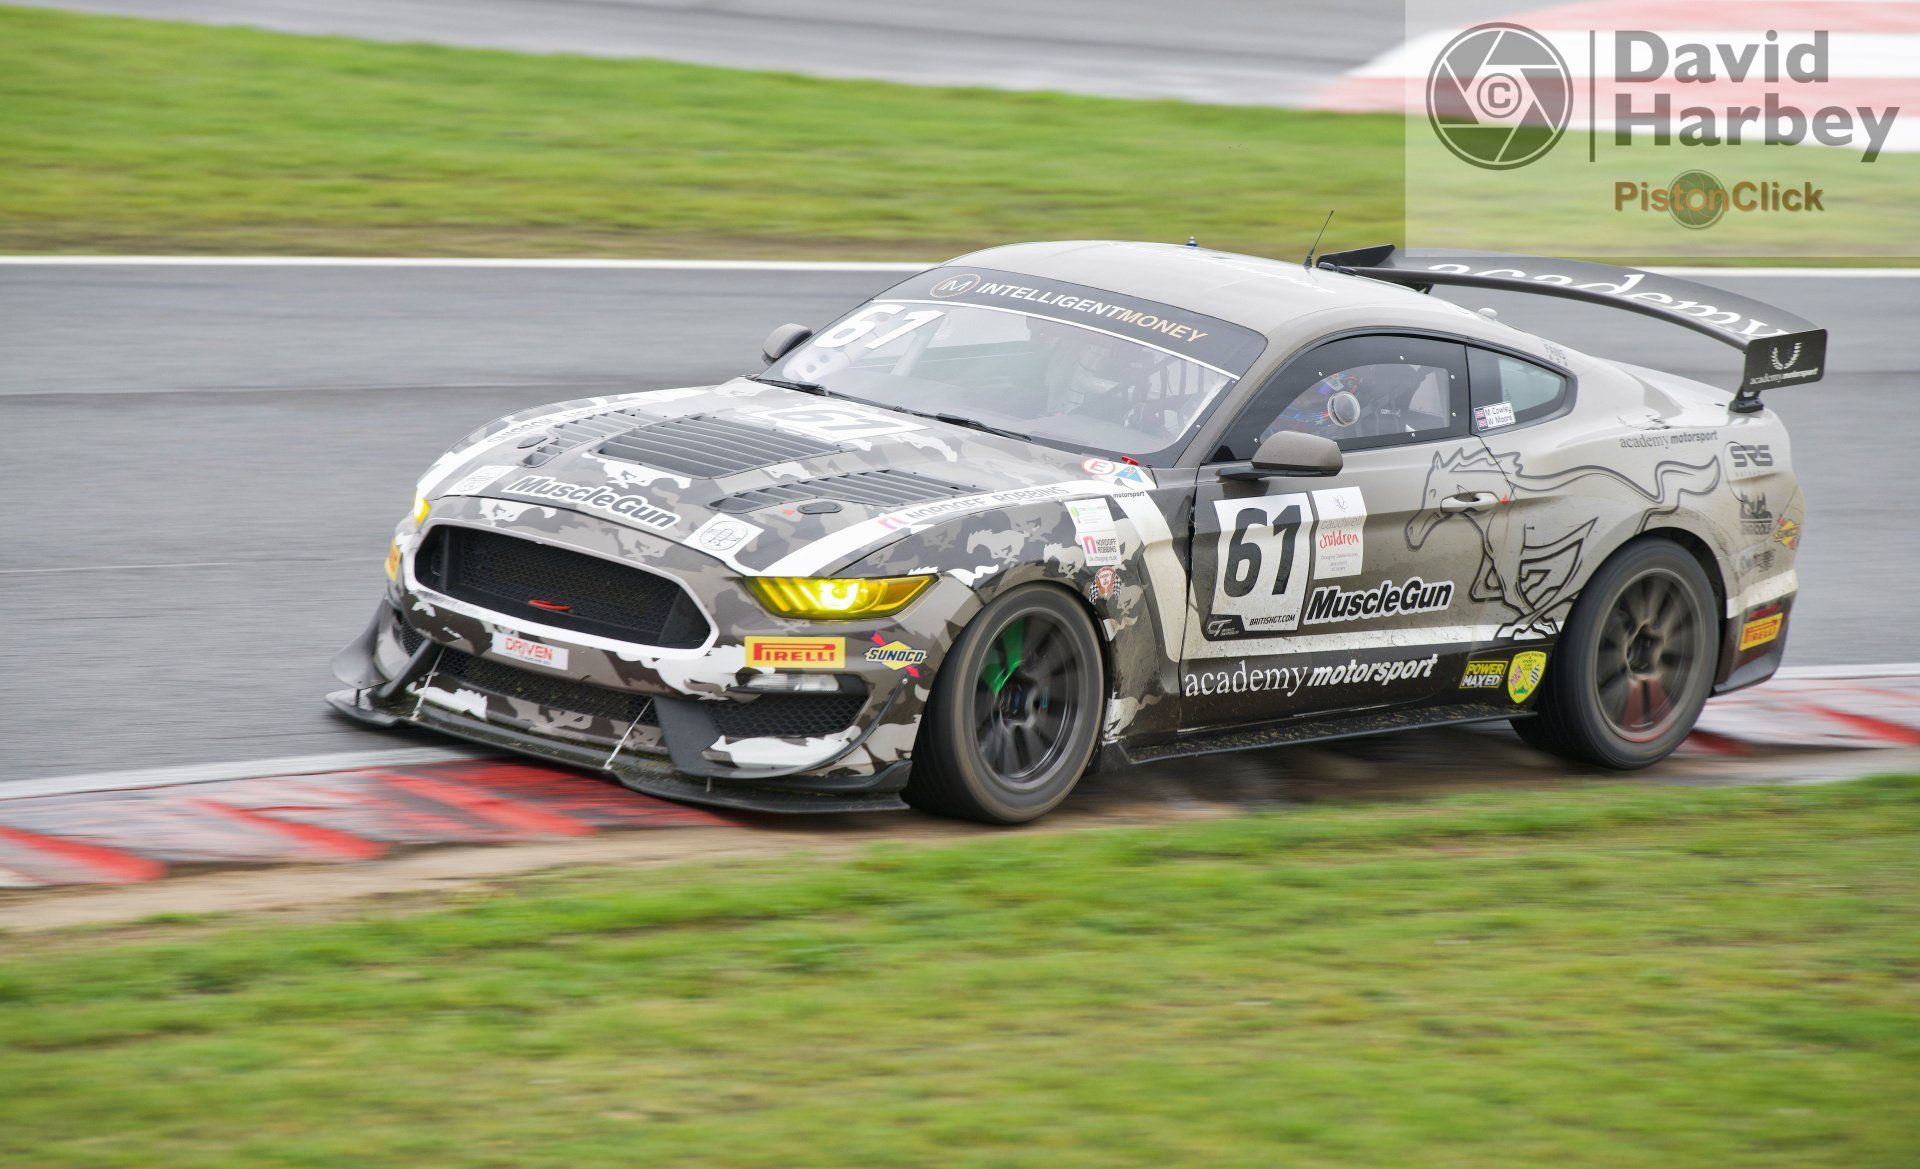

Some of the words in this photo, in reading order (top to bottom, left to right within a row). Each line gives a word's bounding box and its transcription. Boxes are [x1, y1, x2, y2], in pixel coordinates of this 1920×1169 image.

[813, 304, 947, 350] 61
[767, 409, 902, 432] 61
[1619, 434, 1669, 449] academy
[1670, 430, 1718, 444] motorsport
[507, 476, 677, 529] MuscleGun
[1113, 491, 1145, 499] motorsport
[1320, 529, 1360, 549] children
[1223, 504, 1302, 598] 61
[1306, 579, 1453, 621] MuscleGun
[1249, 614, 1296, 626] BRITISHGT.COM
[753, 642, 836, 662] PIRELLI
[868, 649, 926, 663] SUNOCO
[1184, 660, 1309, 697] academy
[1307, 653, 1439, 687] motorsport
[1466, 663, 1505, 675] POWER
[1462, 674, 1502, 688] MAXED
